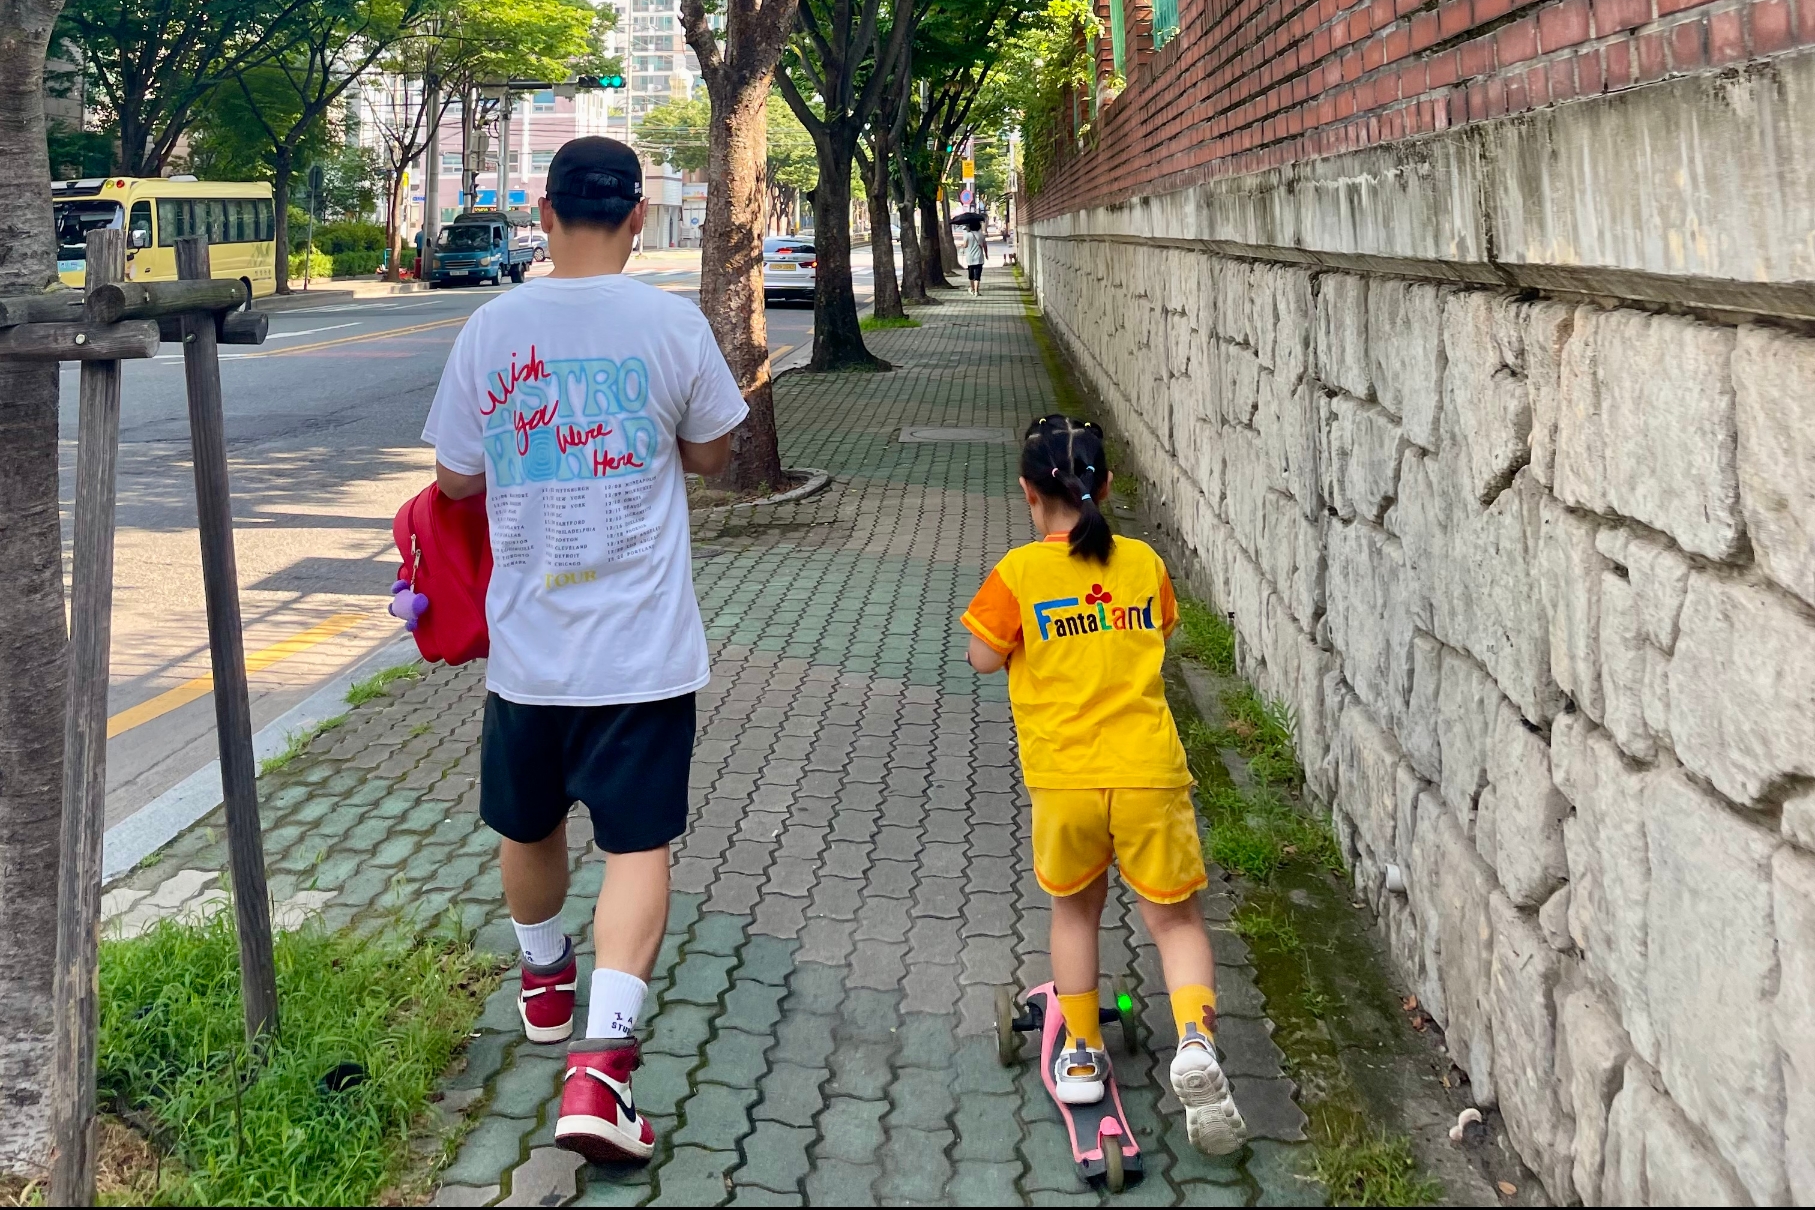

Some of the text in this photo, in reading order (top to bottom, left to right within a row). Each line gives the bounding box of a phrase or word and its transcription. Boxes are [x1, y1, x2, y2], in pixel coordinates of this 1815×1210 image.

[486, 357, 649, 430] ASTRO
[593, 449, 644, 477] Here
[1033, 596, 1157, 642] FantaLand
